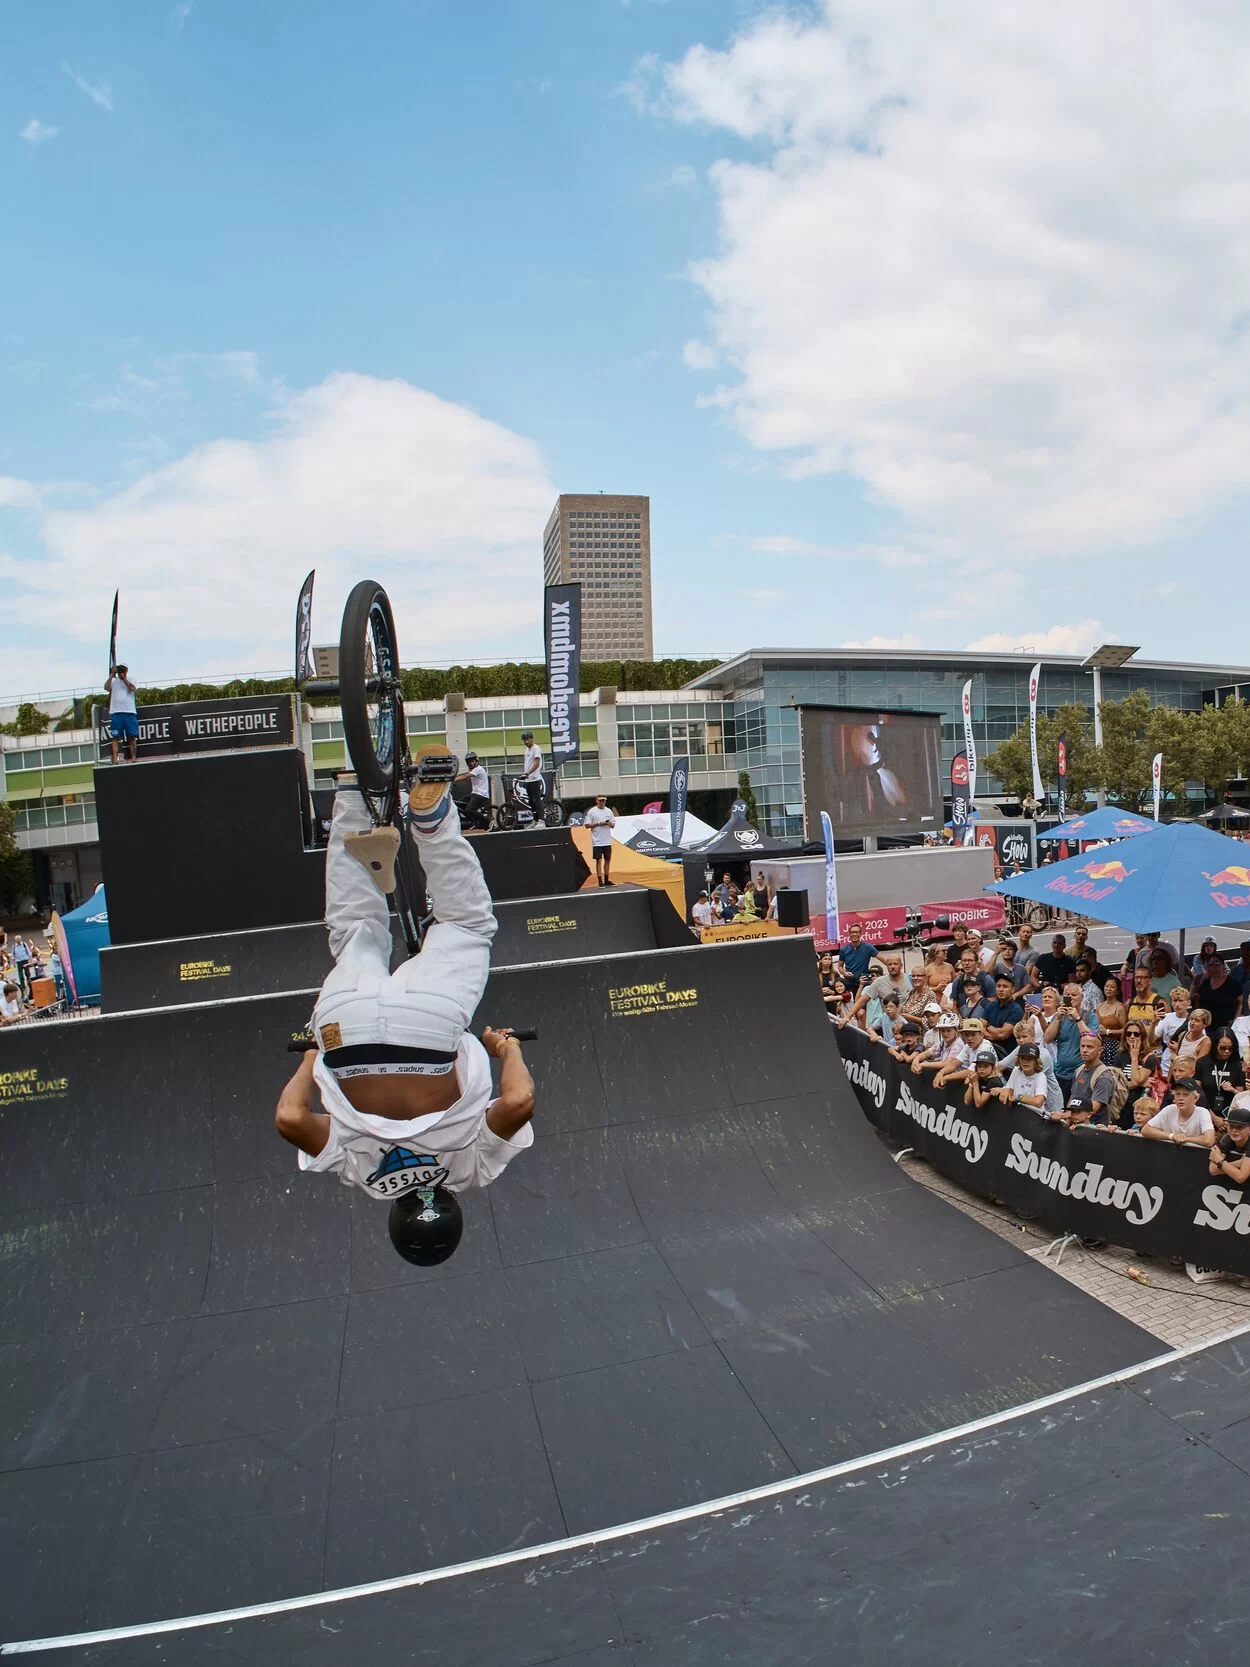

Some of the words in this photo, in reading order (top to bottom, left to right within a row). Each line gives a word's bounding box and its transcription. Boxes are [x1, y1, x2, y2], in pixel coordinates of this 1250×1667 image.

[185, 712, 277, 736] WETHEPEOPLE
[865, 919, 889, 930] 2023
[949, 909, 989, 923] ROBIKE
[608, 981, 667, 1000] EUROBIKE
[610, 995, 665, 1010] FESTIVAL
[666, 989, 698, 1003] DAYS
[36, 1078, 69, 1092] DAYS
[841, 1057, 886, 1108] nday
[897, 1081, 989, 1163] Sunday
[1005, 1133, 1163, 1225] Sunday
